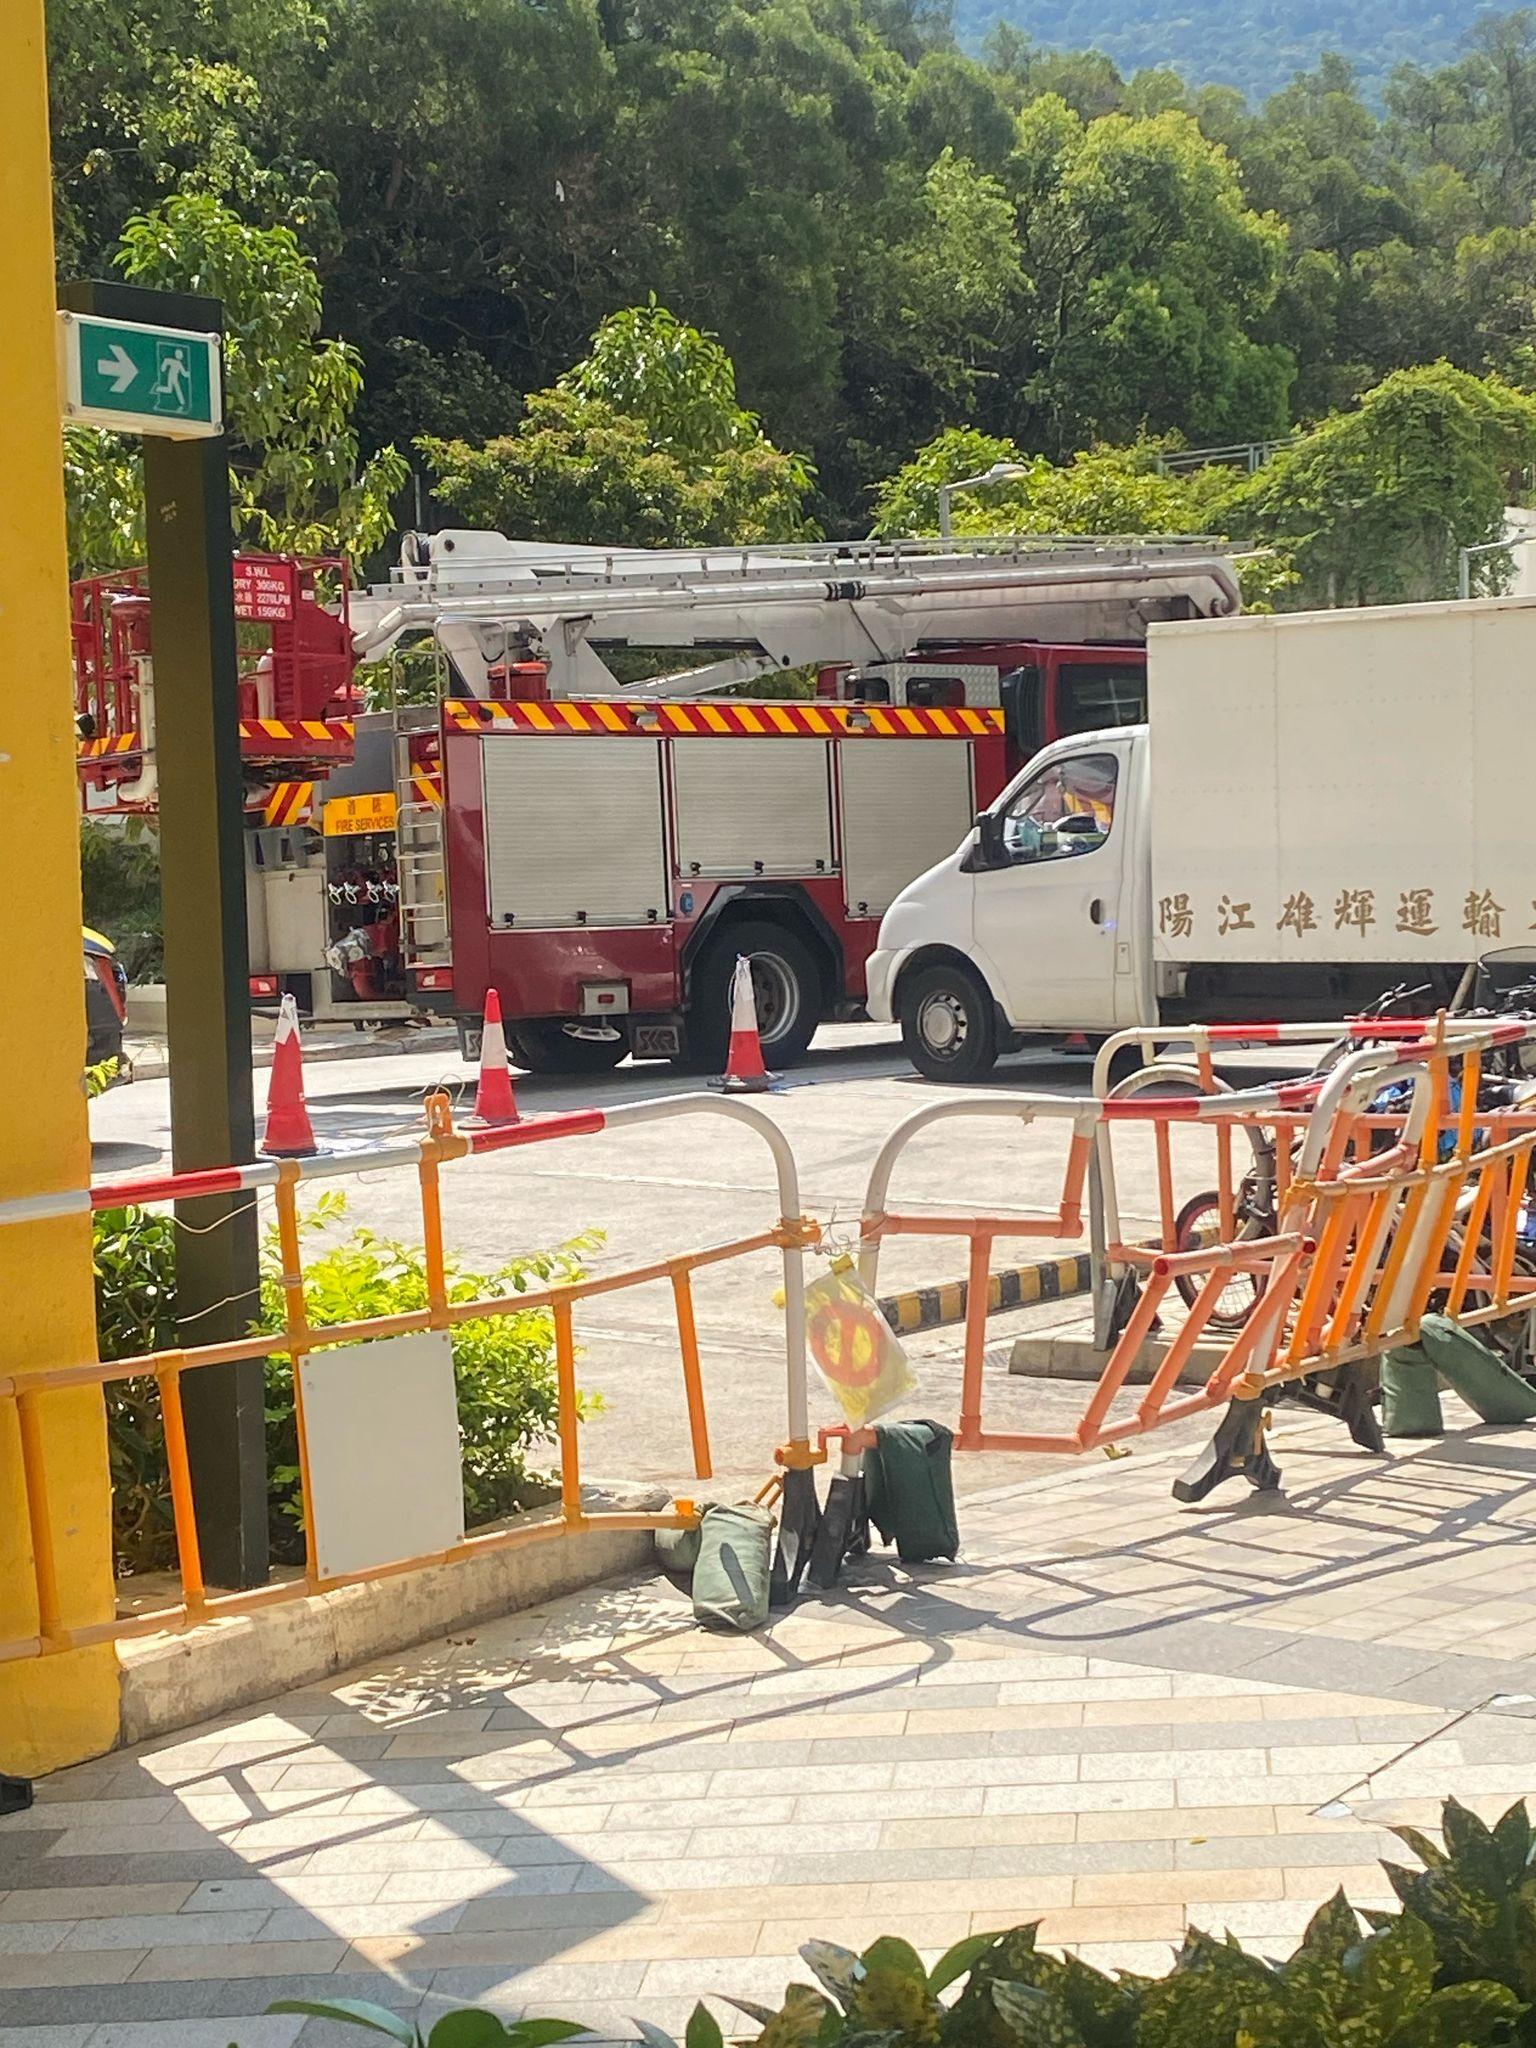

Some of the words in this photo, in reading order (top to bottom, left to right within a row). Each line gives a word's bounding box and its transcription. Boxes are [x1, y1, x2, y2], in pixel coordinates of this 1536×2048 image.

[335, 818, 354, 833] FIRE
[355, 815, 395, 832] SERVICES
[1158, 888, 1536, 938] 陽江雄輝運輸
